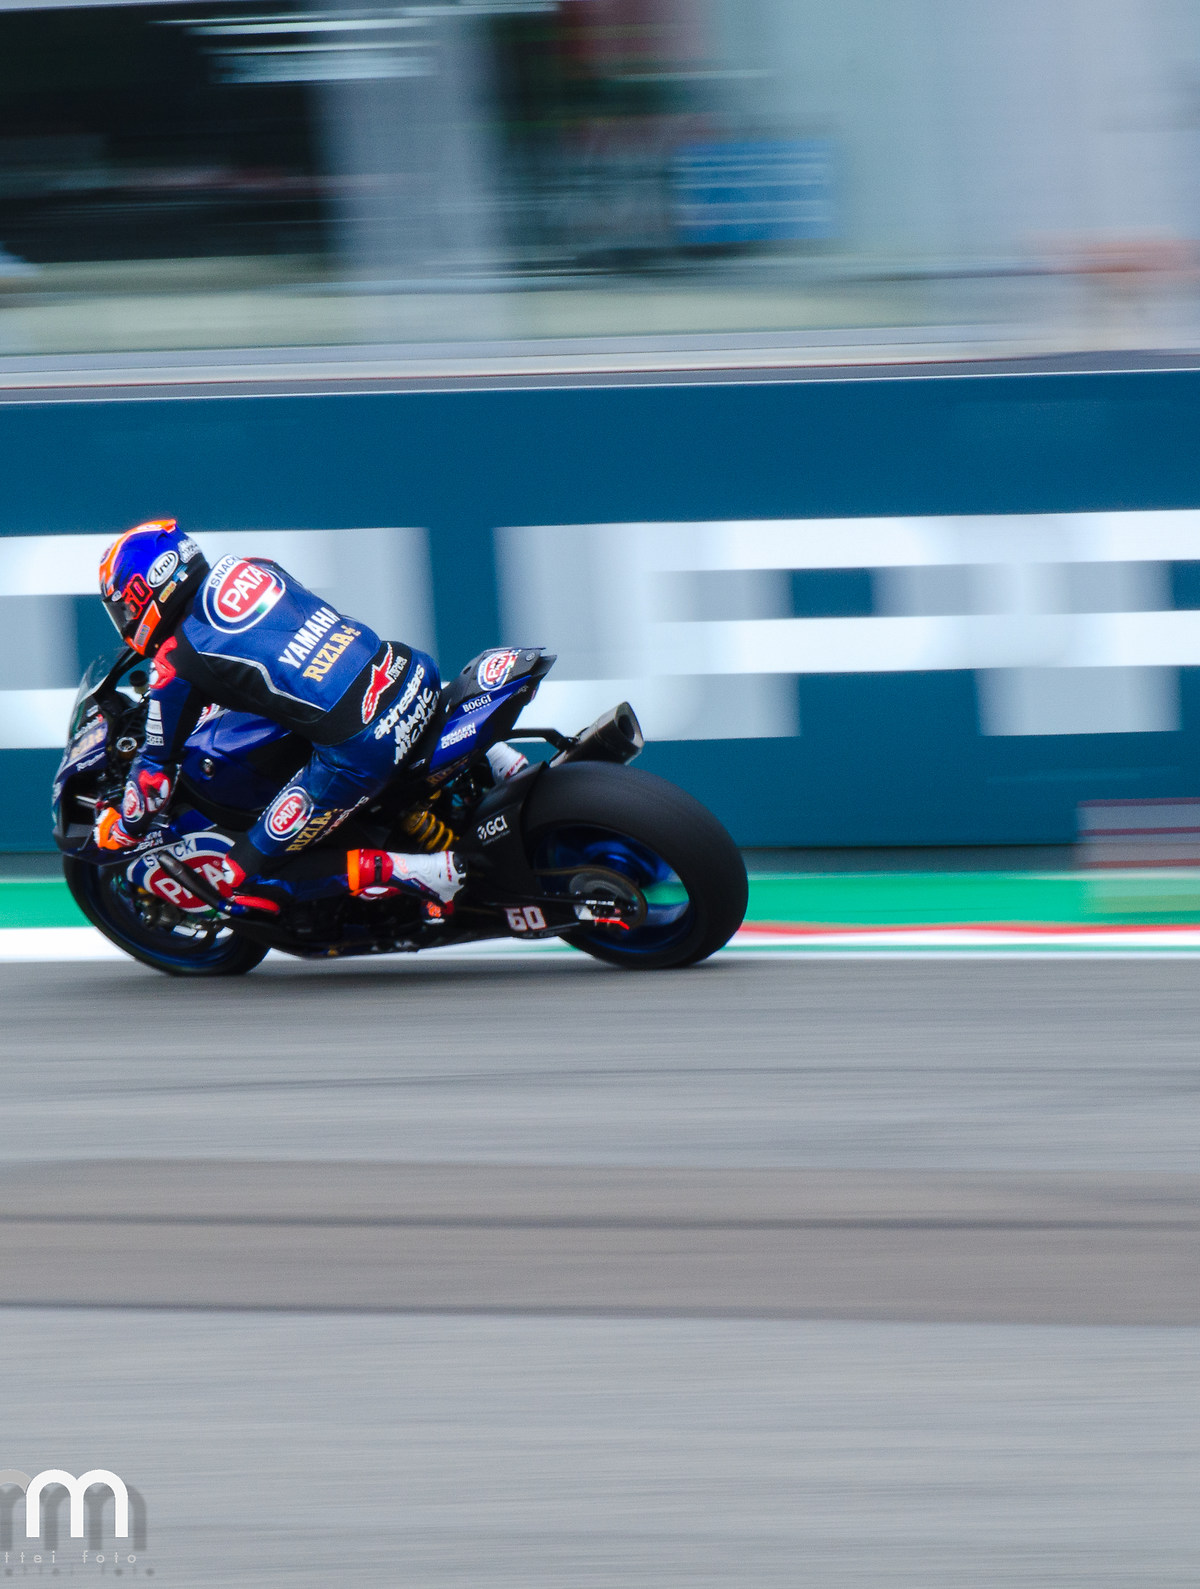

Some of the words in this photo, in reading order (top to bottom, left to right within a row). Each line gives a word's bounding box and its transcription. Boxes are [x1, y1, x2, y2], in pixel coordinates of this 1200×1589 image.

[220, 564, 269, 613] PATA
[278, 606, 341, 669] YAMAHA
[374, 664, 425, 740] alpinestars
[462, 694, 493, 713] BOGGI
[273, 799, 301, 830] PATA
[485, 815, 508, 836] GCI
[144, 840, 194, 868] SCK
[154, 862, 227, 905] PA
[504, 905, 547, 932] 60
